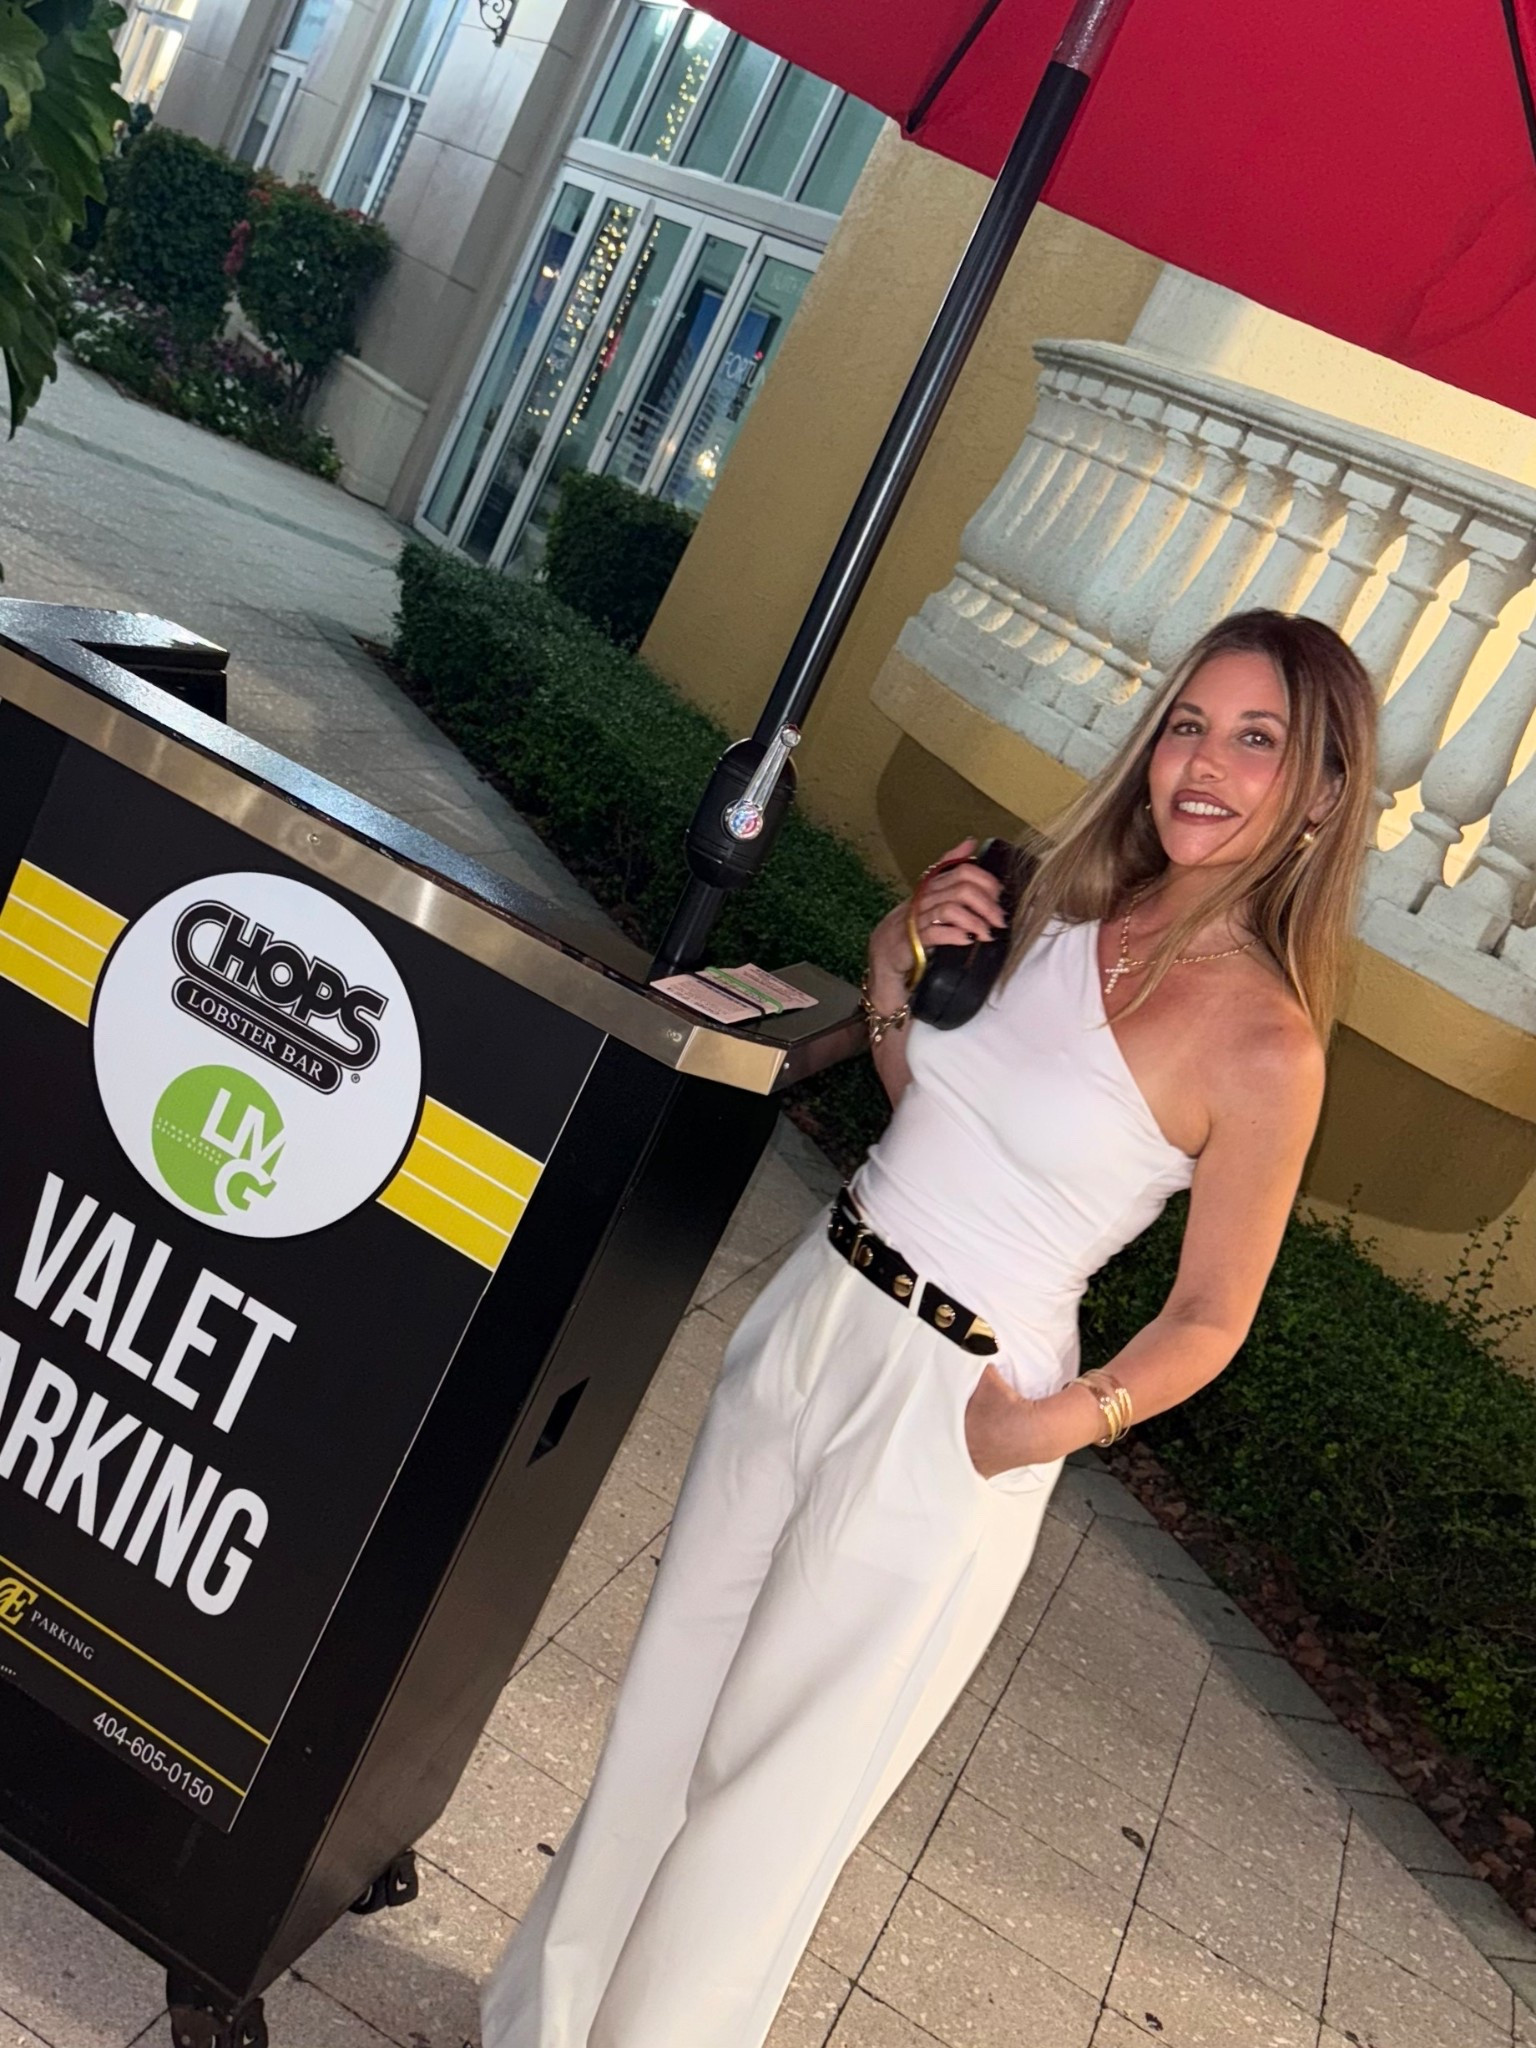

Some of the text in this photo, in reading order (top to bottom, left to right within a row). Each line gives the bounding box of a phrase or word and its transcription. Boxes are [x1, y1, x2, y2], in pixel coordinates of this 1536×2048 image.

[171, 899, 390, 1071] CHOPS
[187, 988, 323, 1081] LOBSTER BAR
[14, 1171, 297, 1434] VALET
[0, 1330, 269, 1616] RKING
[30, 1609, 95, 1660] PARKING
[93, 1711, 214, 1806] 404-605-0150
